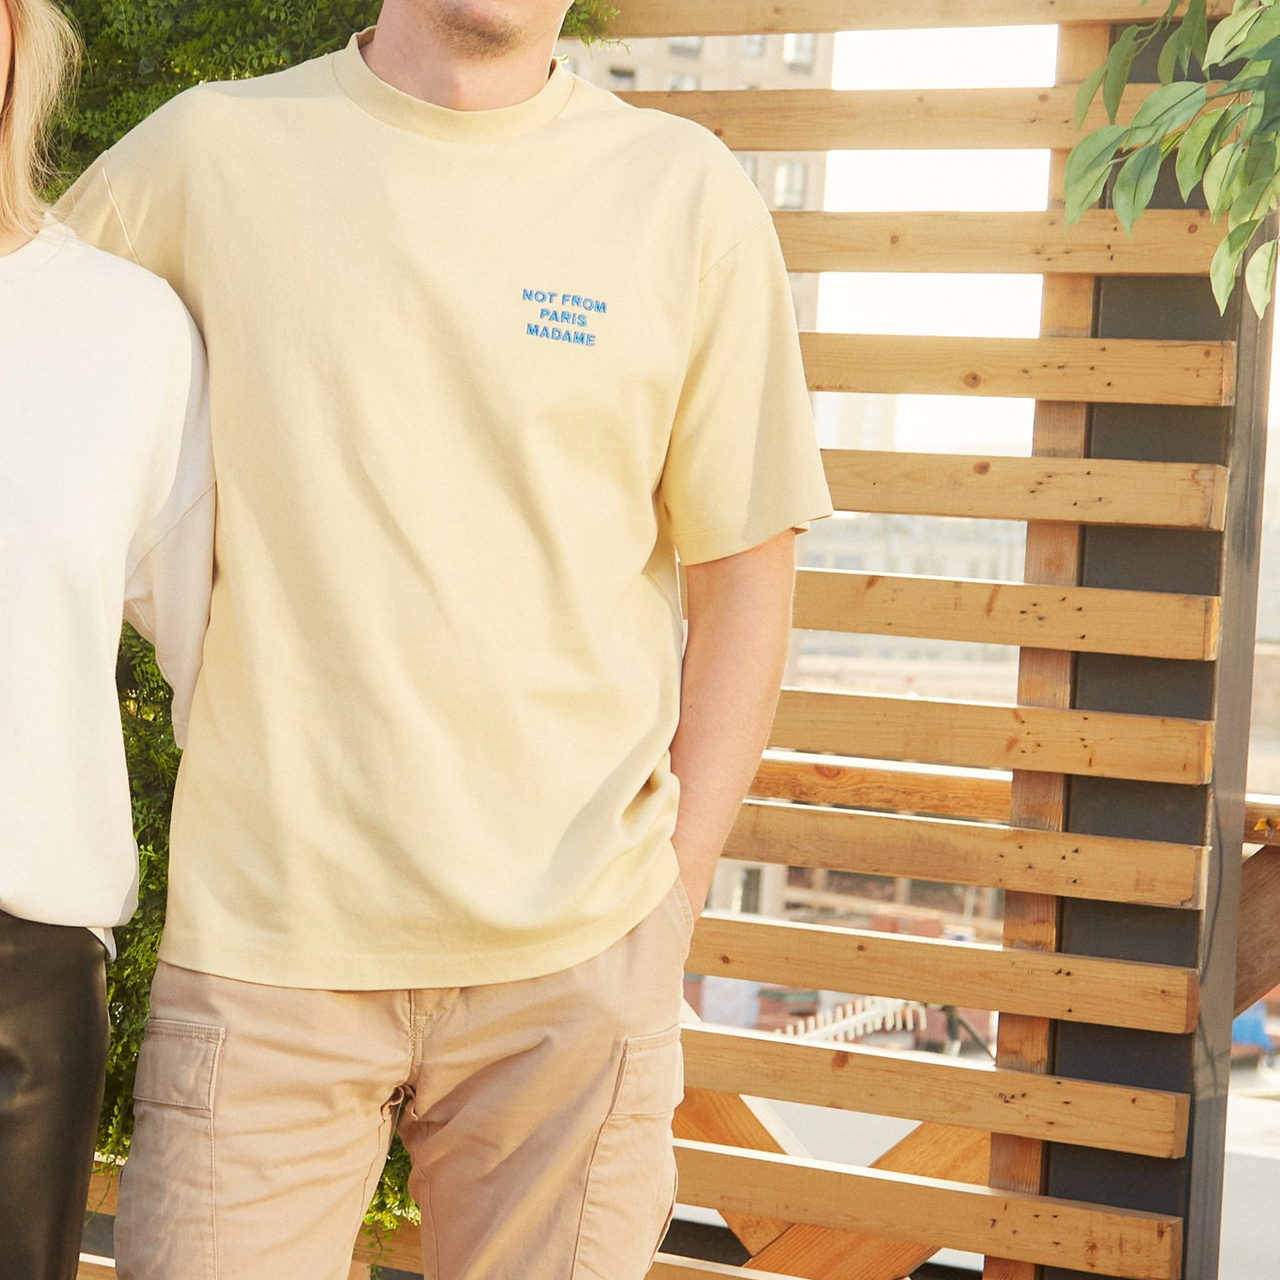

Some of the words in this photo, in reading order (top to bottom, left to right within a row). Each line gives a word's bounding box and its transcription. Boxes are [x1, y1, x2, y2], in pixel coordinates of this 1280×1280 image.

[523, 289, 558, 303] NOT
[561, 294, 607, 313] FROM
[540, 308, 587, 327] PARIS
[526, 323, 596, 346] MADAME
